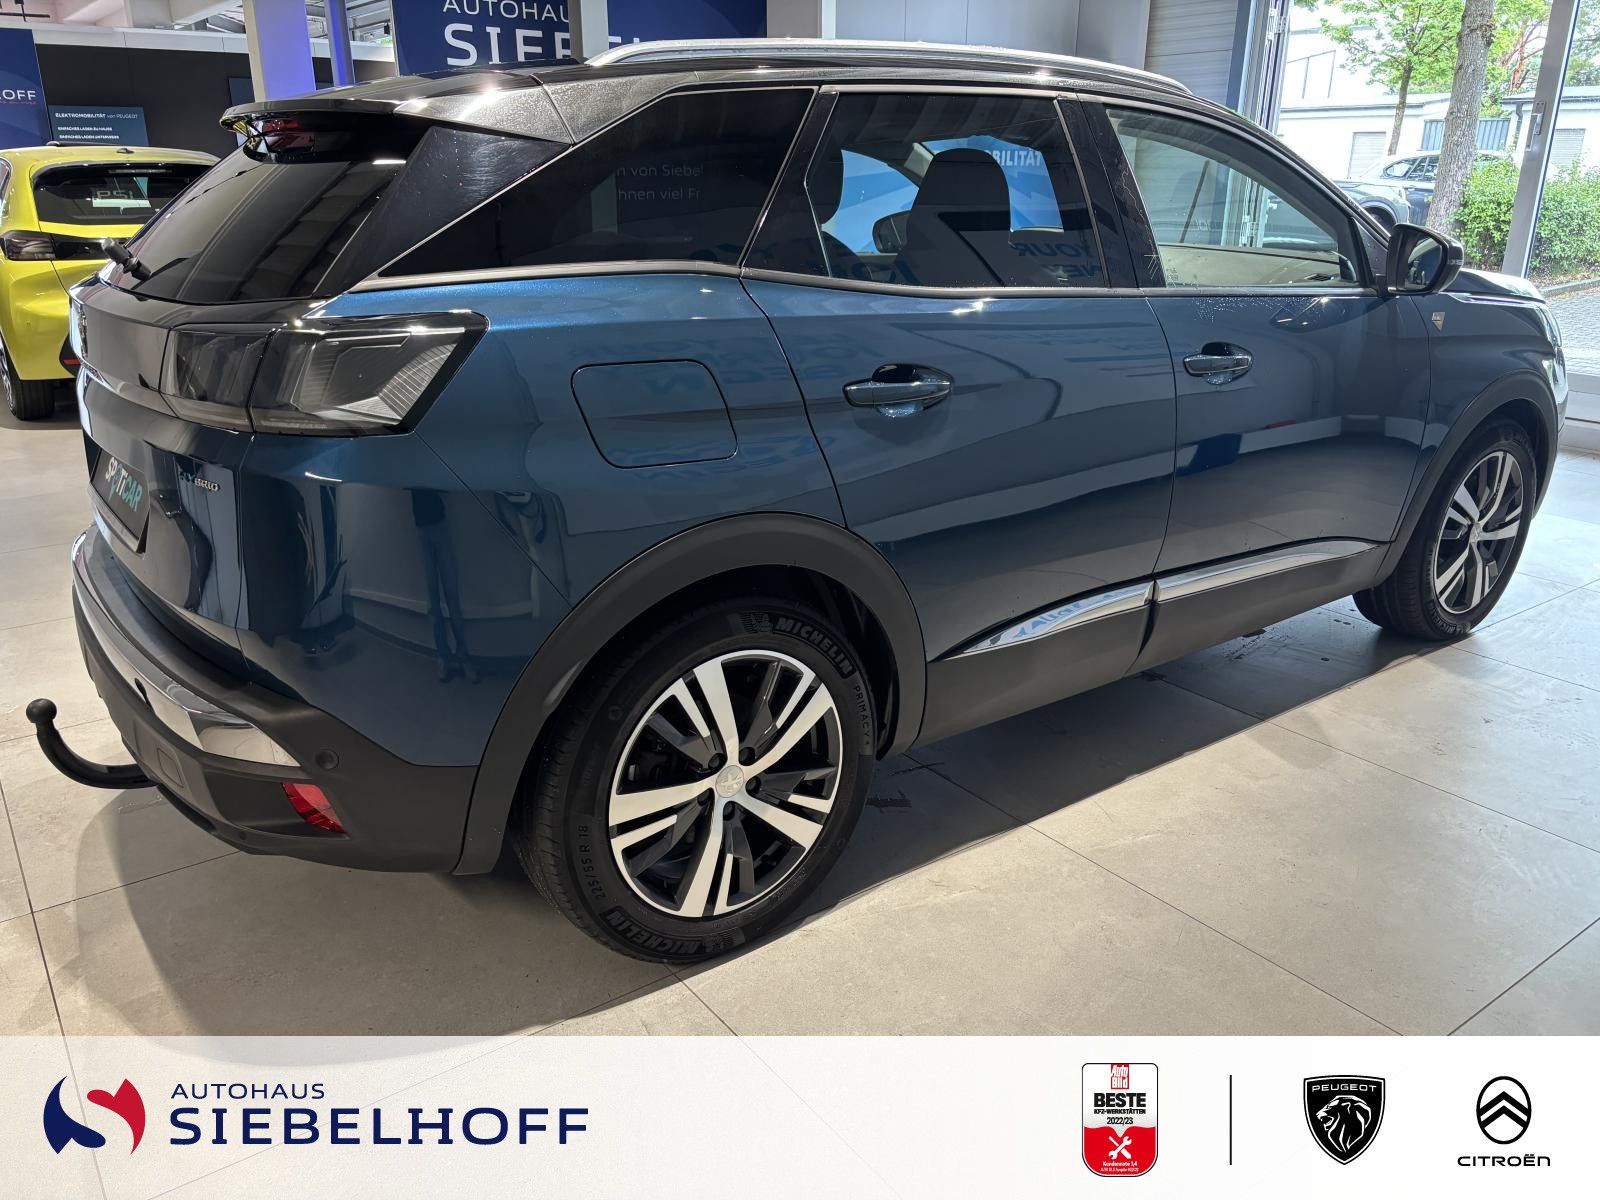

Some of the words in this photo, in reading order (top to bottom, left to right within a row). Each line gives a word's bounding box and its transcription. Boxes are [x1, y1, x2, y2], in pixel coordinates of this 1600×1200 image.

[0, 89, 36, 101] OFF
[630, 167, 657, 176] von
[775, 616, 854, 676] MICHELIN
[853, 685, 870, 737] PRIMACY
[578, 825, 589, 838] 18
[580, 844, 590, 853] R
[581, 857, 606, 899] 225/55
[606, 910, 701, 955] MICHELIN
